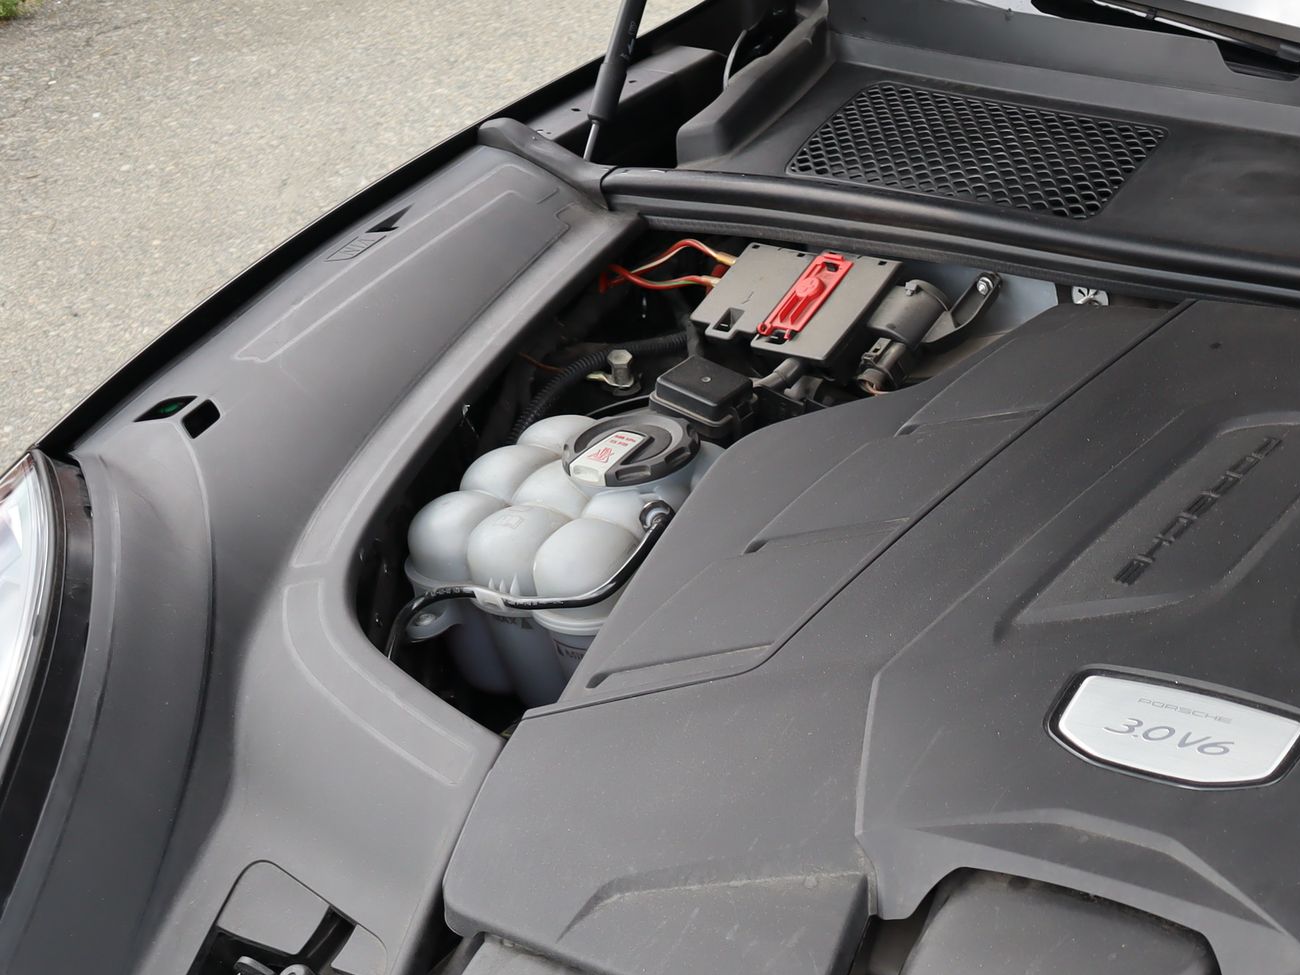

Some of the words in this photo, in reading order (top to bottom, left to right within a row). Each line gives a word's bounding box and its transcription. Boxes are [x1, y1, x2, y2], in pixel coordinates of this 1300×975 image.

[1137, 697, 1233, 724] PORSCHE
[1103, 717, 1176, 742] 3.0
[1177, 732, 1235, 756] V6
